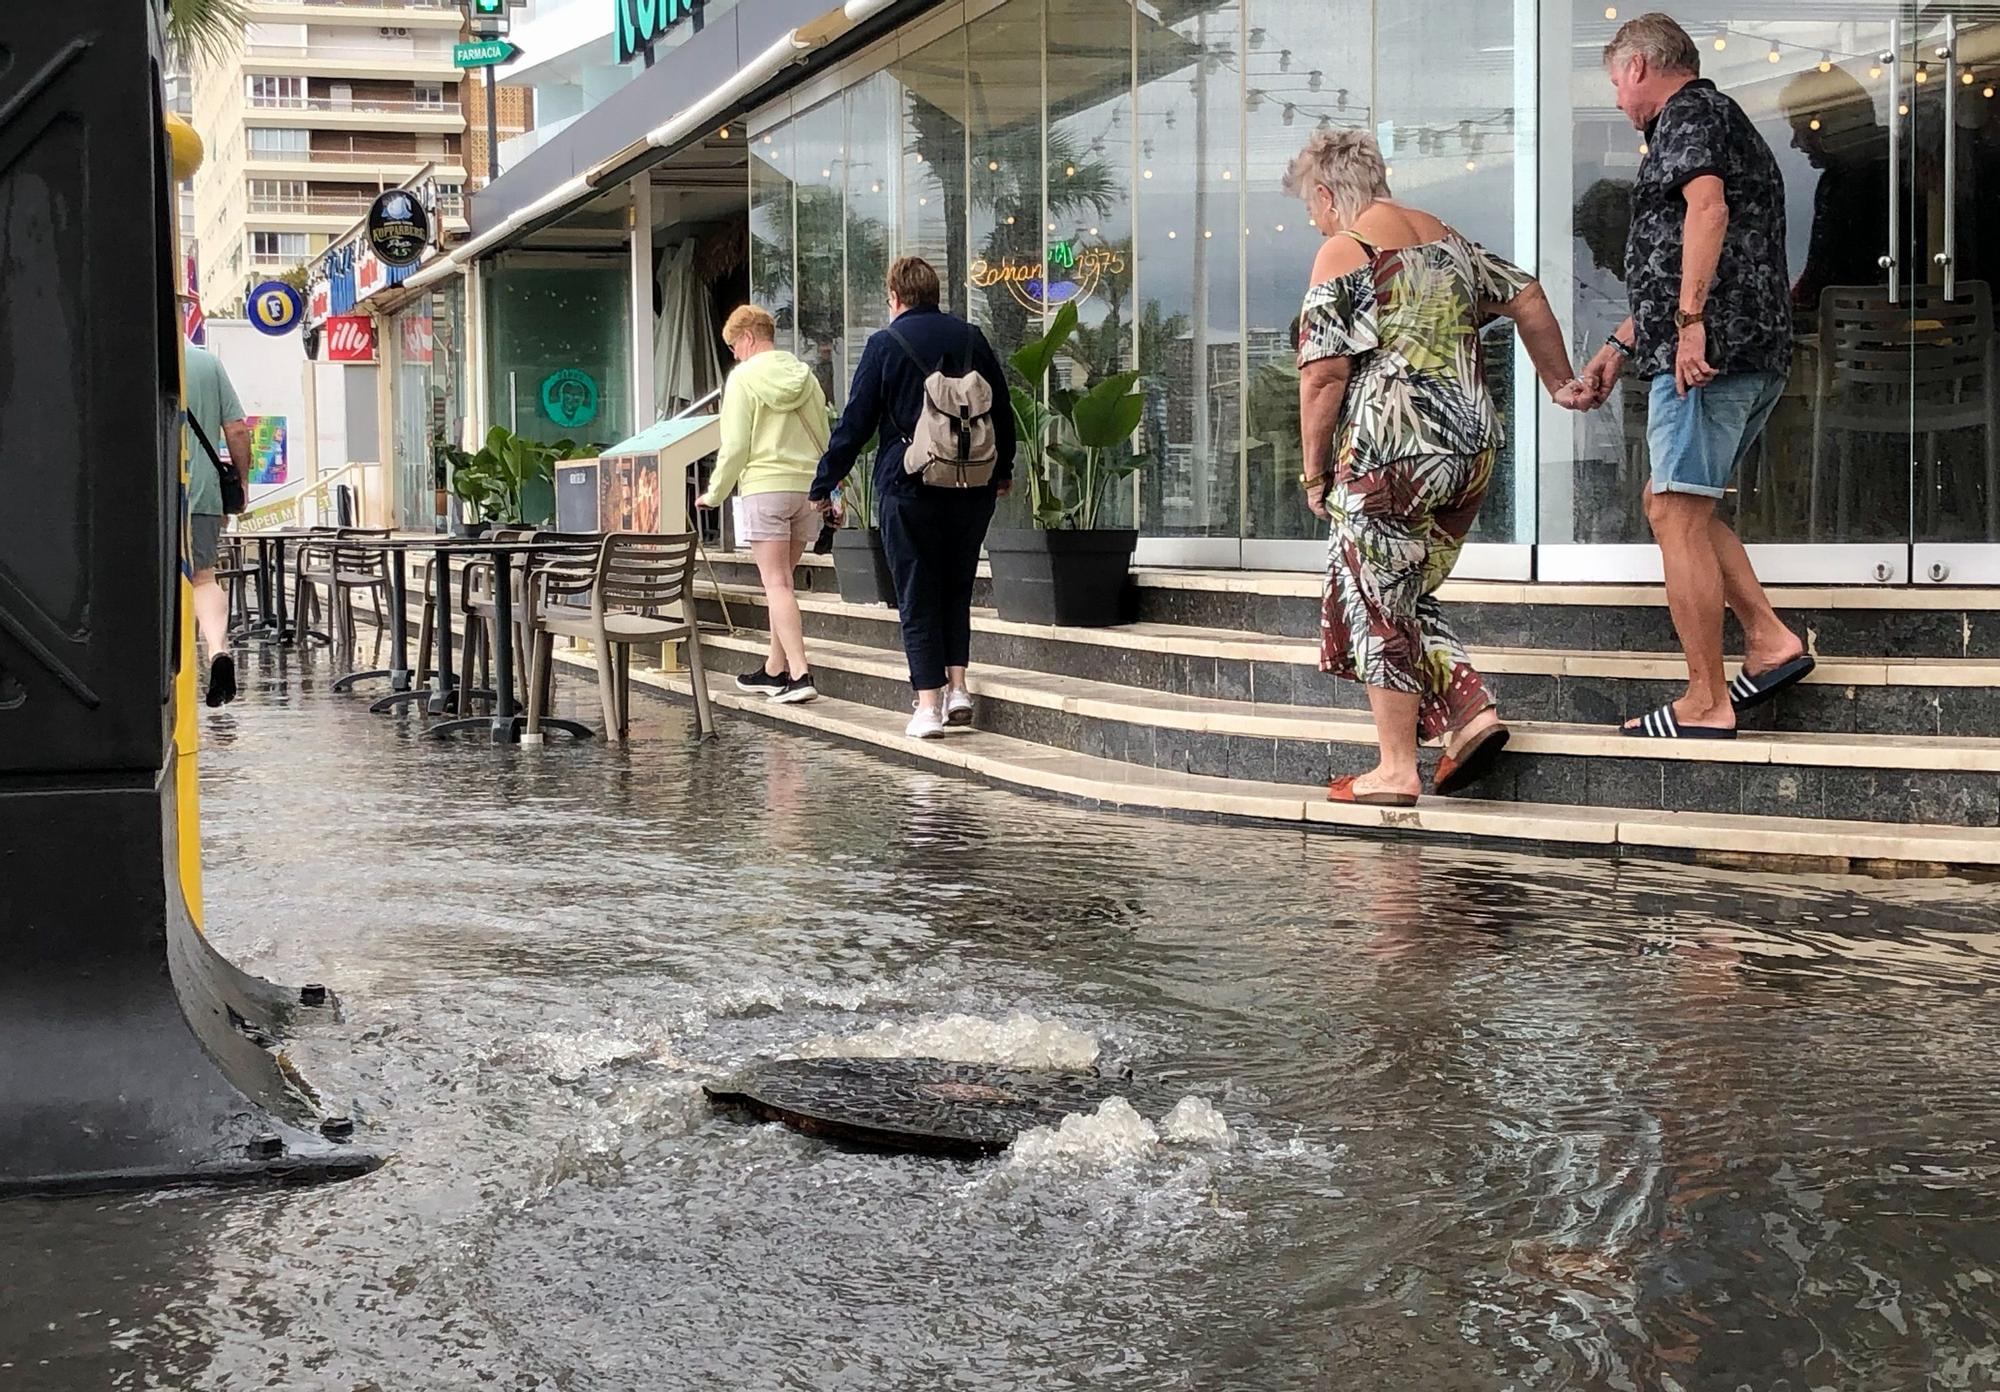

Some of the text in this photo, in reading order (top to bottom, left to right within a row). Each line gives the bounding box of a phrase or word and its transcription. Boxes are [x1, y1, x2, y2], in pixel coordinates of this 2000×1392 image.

[457, 46, 502, 61] FARMACIA
[1072, 250, 1125, 279] 1975
[268, 301, 281, 318] F
[330, 322, 370, 358] illy
[240, 512, 281, 533] SUPER
